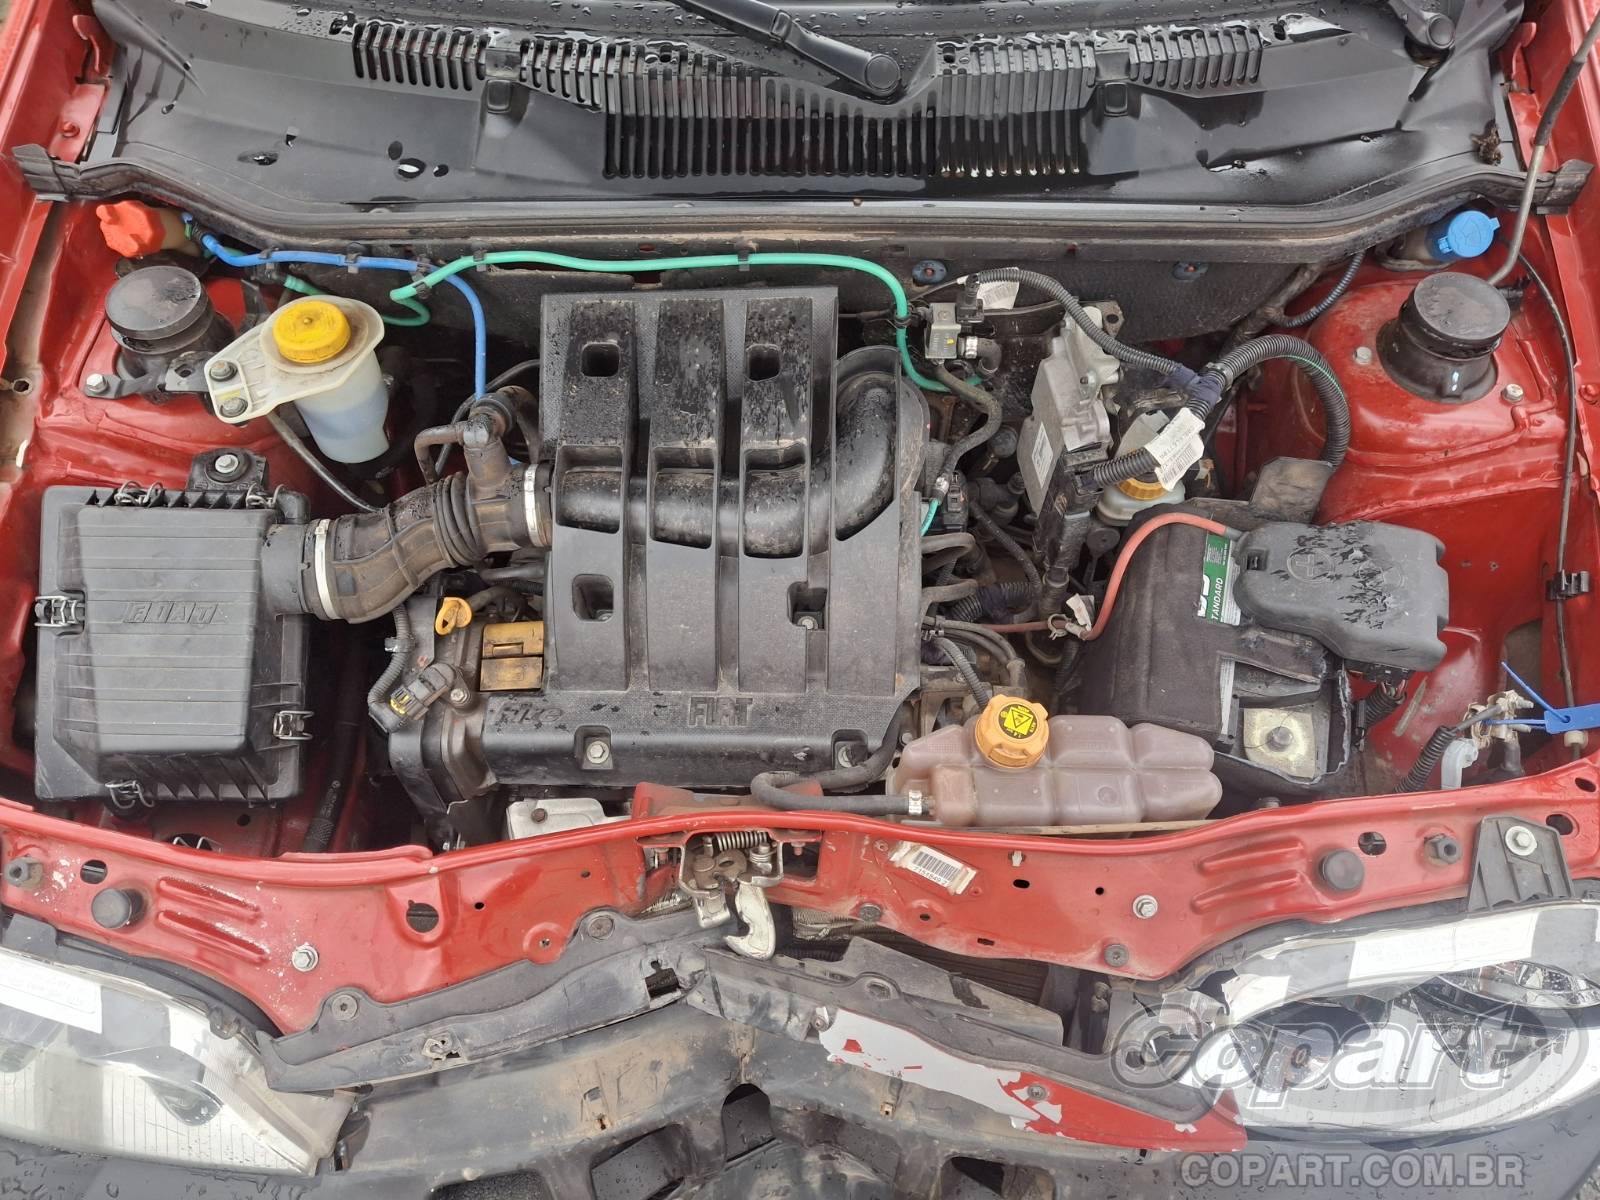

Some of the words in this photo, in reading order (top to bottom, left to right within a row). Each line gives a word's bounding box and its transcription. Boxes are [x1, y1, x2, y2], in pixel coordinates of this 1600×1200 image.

[124, 601, 217, 624] FIAT
[1211, 577, 1223, 620] TANDARD
[689, 697, 753, 726] FIAT
